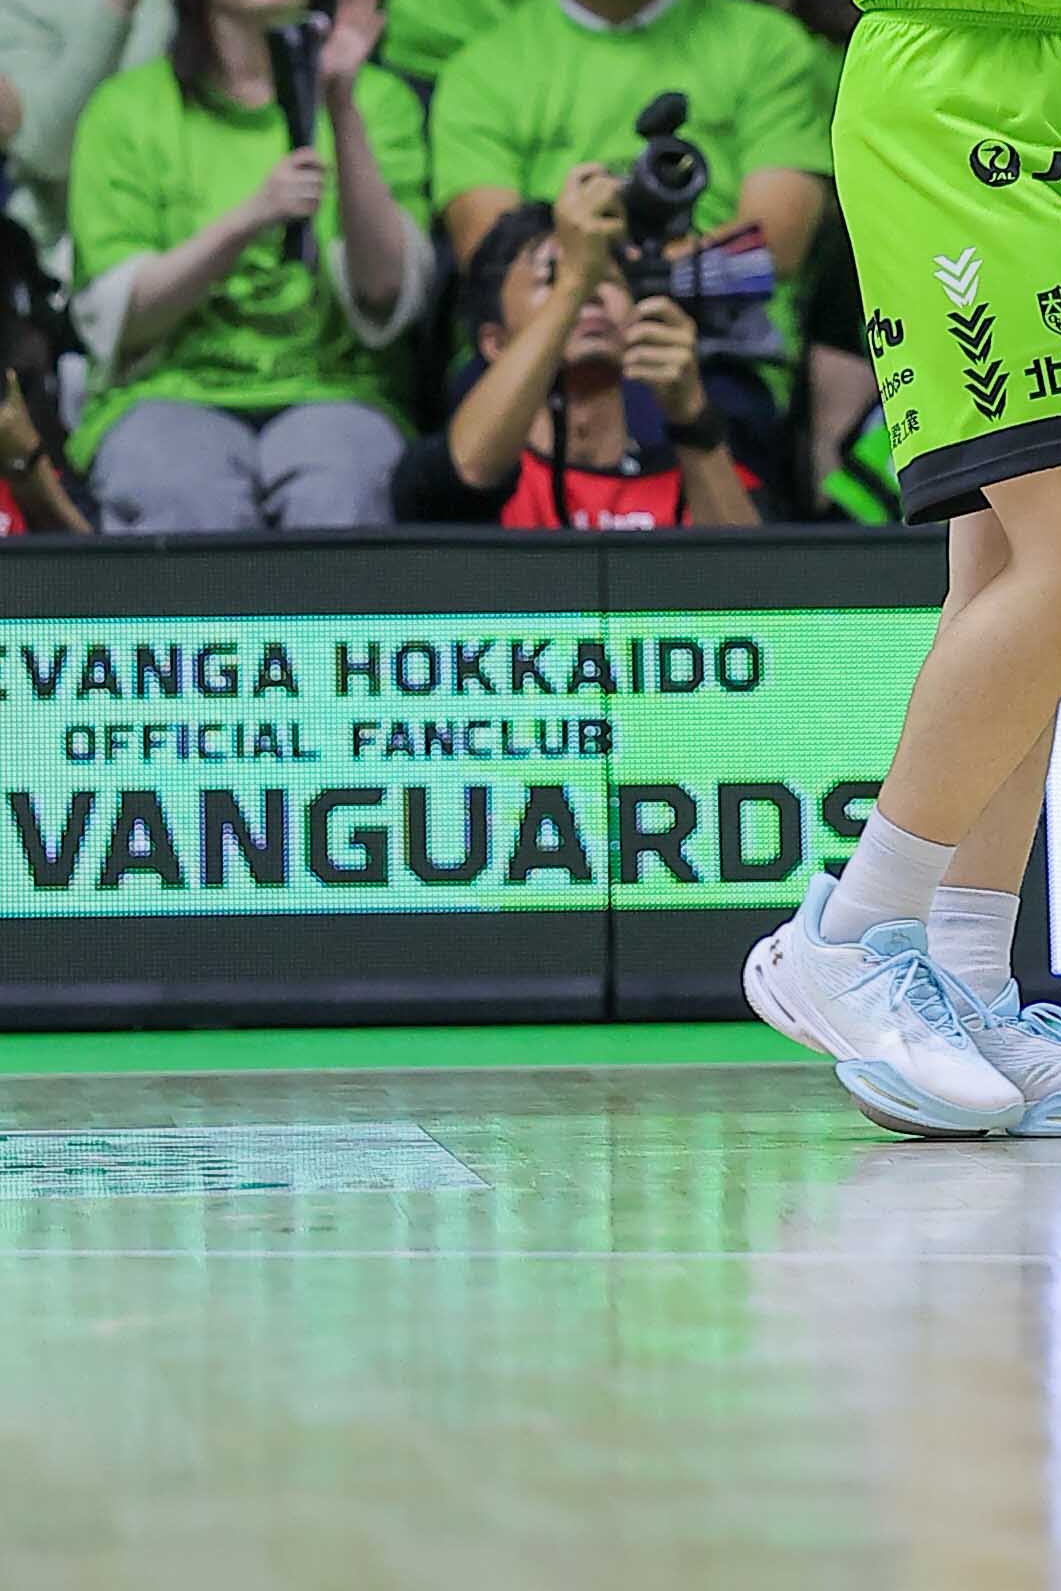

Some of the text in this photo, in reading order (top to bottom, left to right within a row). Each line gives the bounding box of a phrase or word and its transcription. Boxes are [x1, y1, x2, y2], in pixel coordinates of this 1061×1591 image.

[988, 170, 1017, 183] JAL
[0, 636, 766, 700] VANGA HOKKAIDO
[65, 718, 613, 762] OFFICIAL FANCLUB
